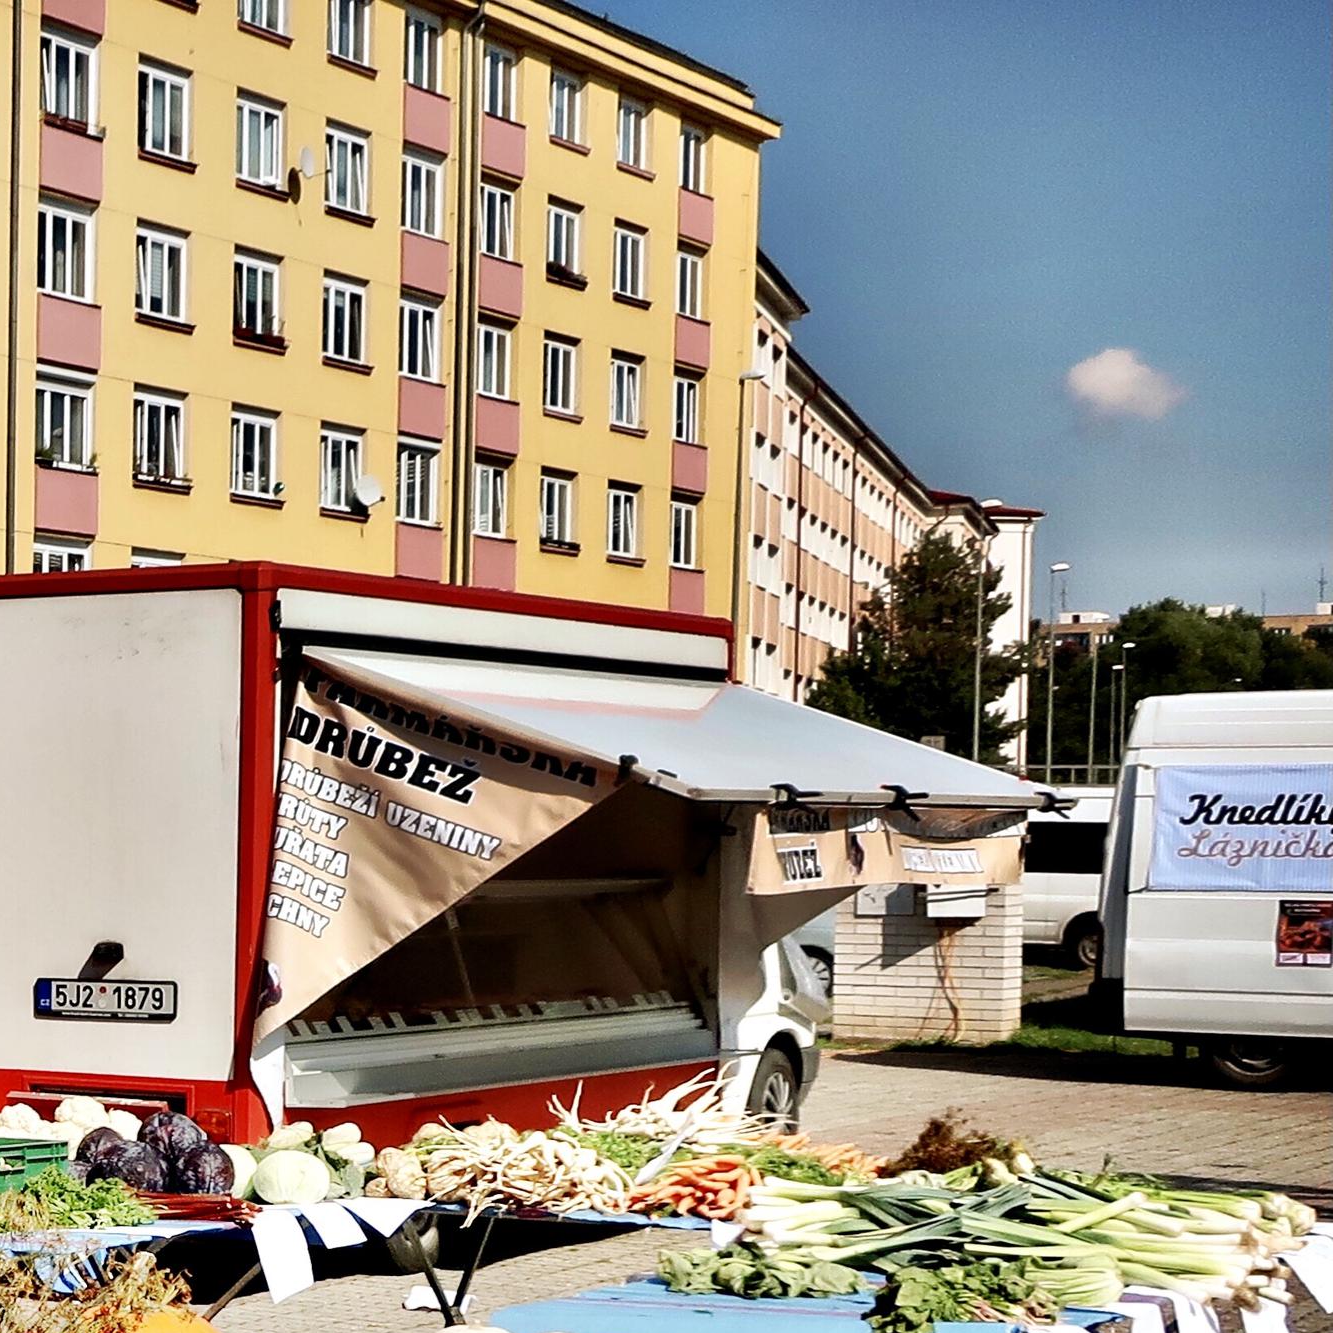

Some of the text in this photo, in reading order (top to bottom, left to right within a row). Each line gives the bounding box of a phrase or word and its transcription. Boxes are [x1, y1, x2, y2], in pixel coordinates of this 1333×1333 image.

[286, 706, 483, 805] DRŮBEŽ
[277, 792, 348, 841] RŮTY
[386, 801, 502, 860] UZENINY
[55, 984, 164, 1010] 5J2 1879
